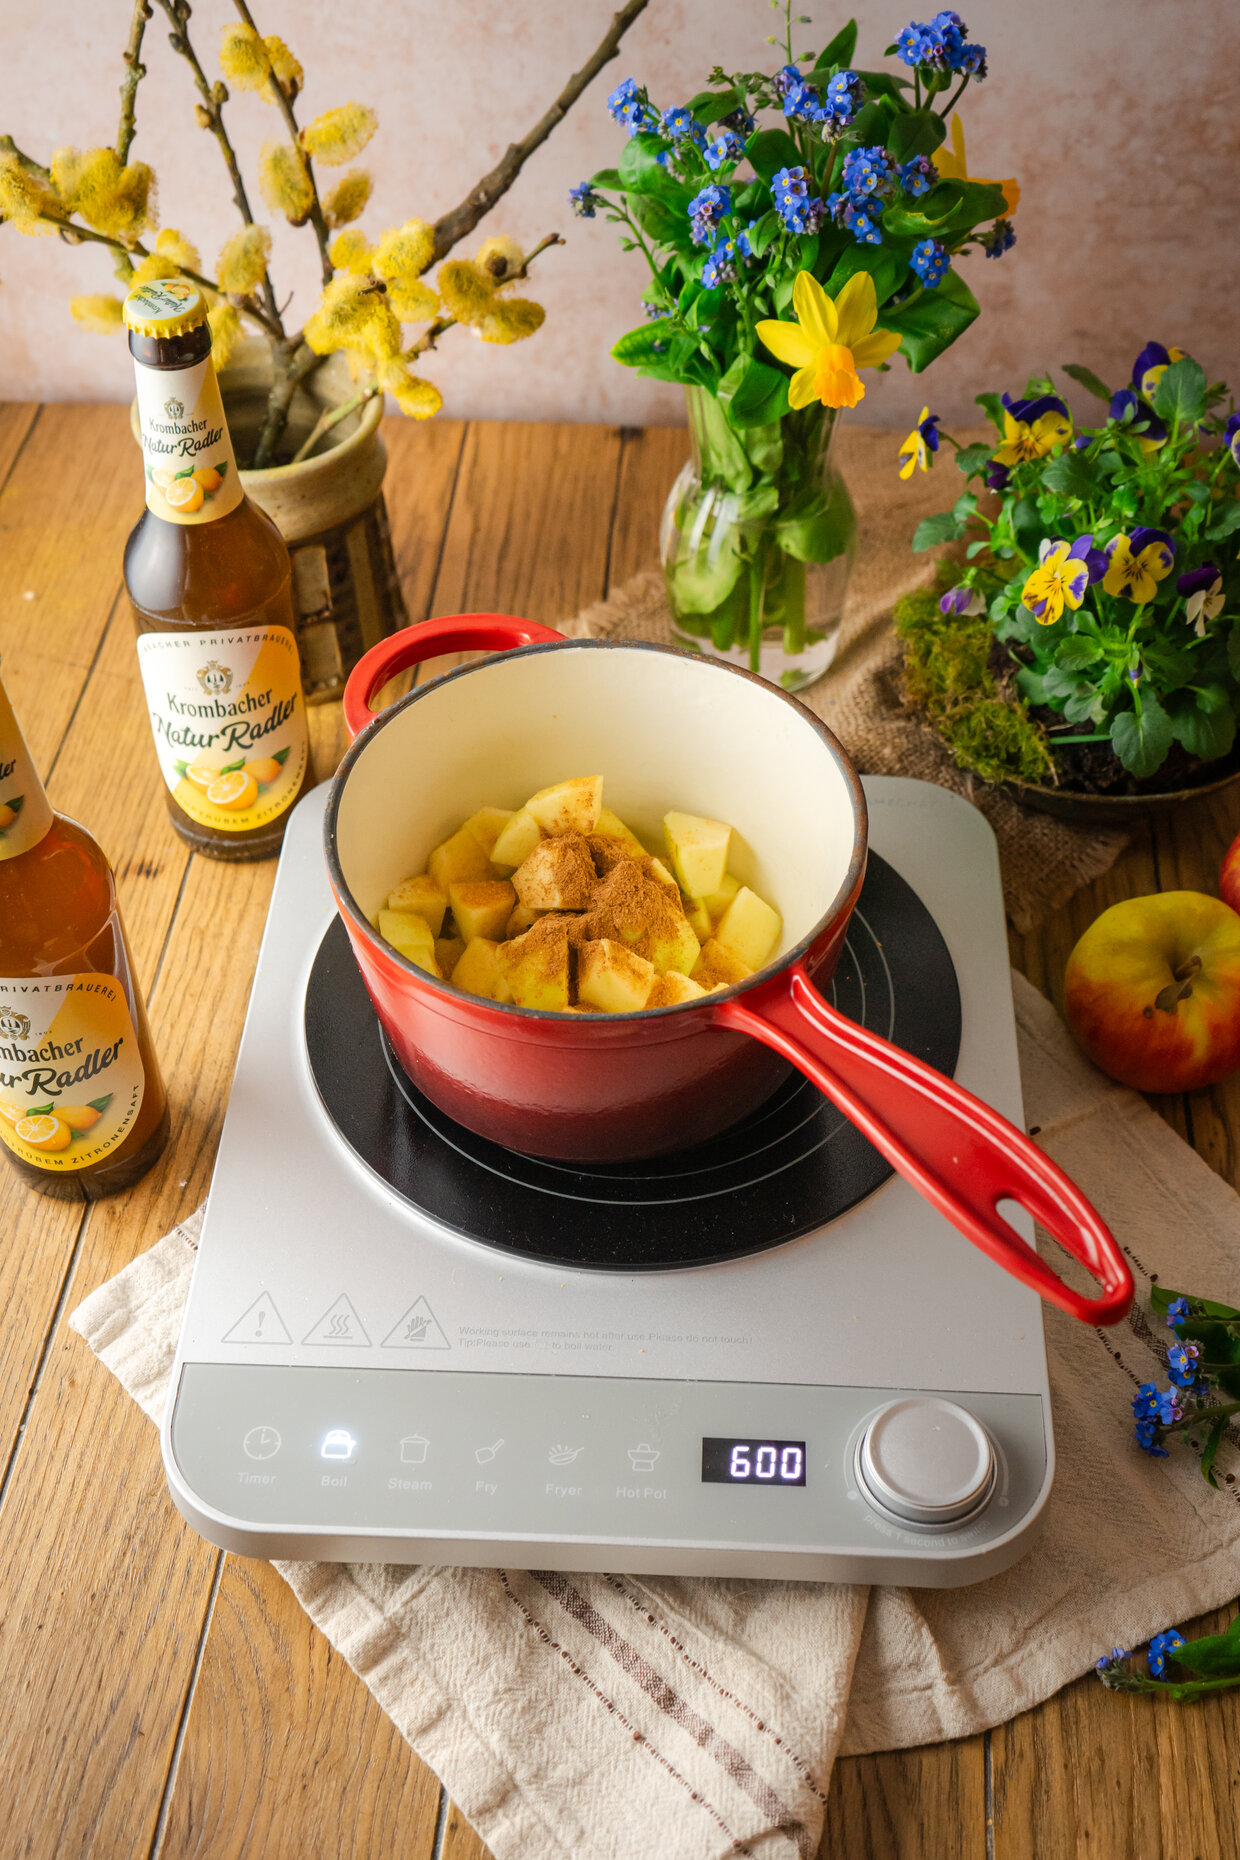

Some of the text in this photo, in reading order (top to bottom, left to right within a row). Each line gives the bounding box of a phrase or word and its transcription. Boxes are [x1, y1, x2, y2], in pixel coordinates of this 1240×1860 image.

[149, 417, 208, 435] Krombacher
[166, 688, 273, 719] Krombacher
[70, 1084, 140, 1166] ZITRONENSAFT
[458, 1326, 499, 1338] Working
[502, 1328, 538, 1338] surface
[729, 1445, 803, 1479] 600
[237, 1471, 277, 1485] Timer
[320, 1475, 348, 1488] Boil
[387, 1477, 433, 1491] Steam
[475, 1480, 498, 1496] Fry
[545, 1483, 583, 1498] Fryer
[615, 1487, 667, 1500] Hot Pot
